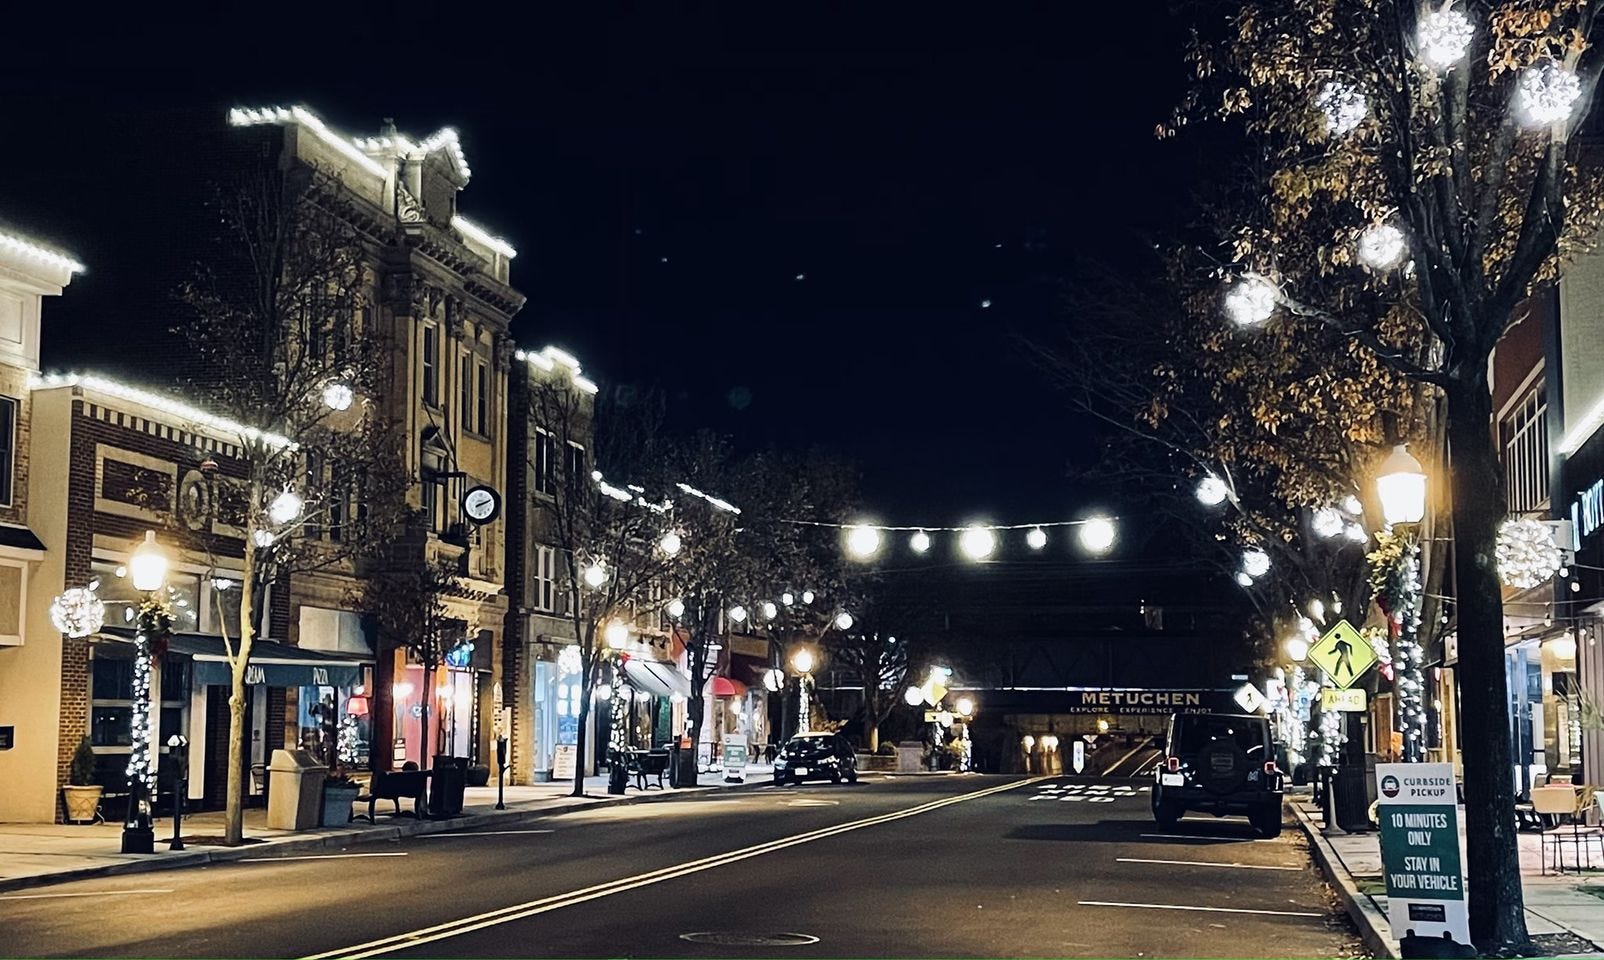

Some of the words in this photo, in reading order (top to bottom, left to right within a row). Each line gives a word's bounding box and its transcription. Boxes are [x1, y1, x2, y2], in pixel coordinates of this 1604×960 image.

[1082, 692, 1200, 705] METUCHEN
[1403, 777, 1451, 786] CURBSIDE
[1410, 788, 1446, 797] PICKUP
[1391, 813, 1403, 828] 10
[1404, 813, 1447, 829] MINUTES
[1407, 831, 1432, 846] ONLY
[1404, 856, 1427, 872] STAY
[1429, 857, 1441, 873] IN
[1390, 874, 1417, 889] YOUR
[1417, 875, 1458, 891] VEHICLE
